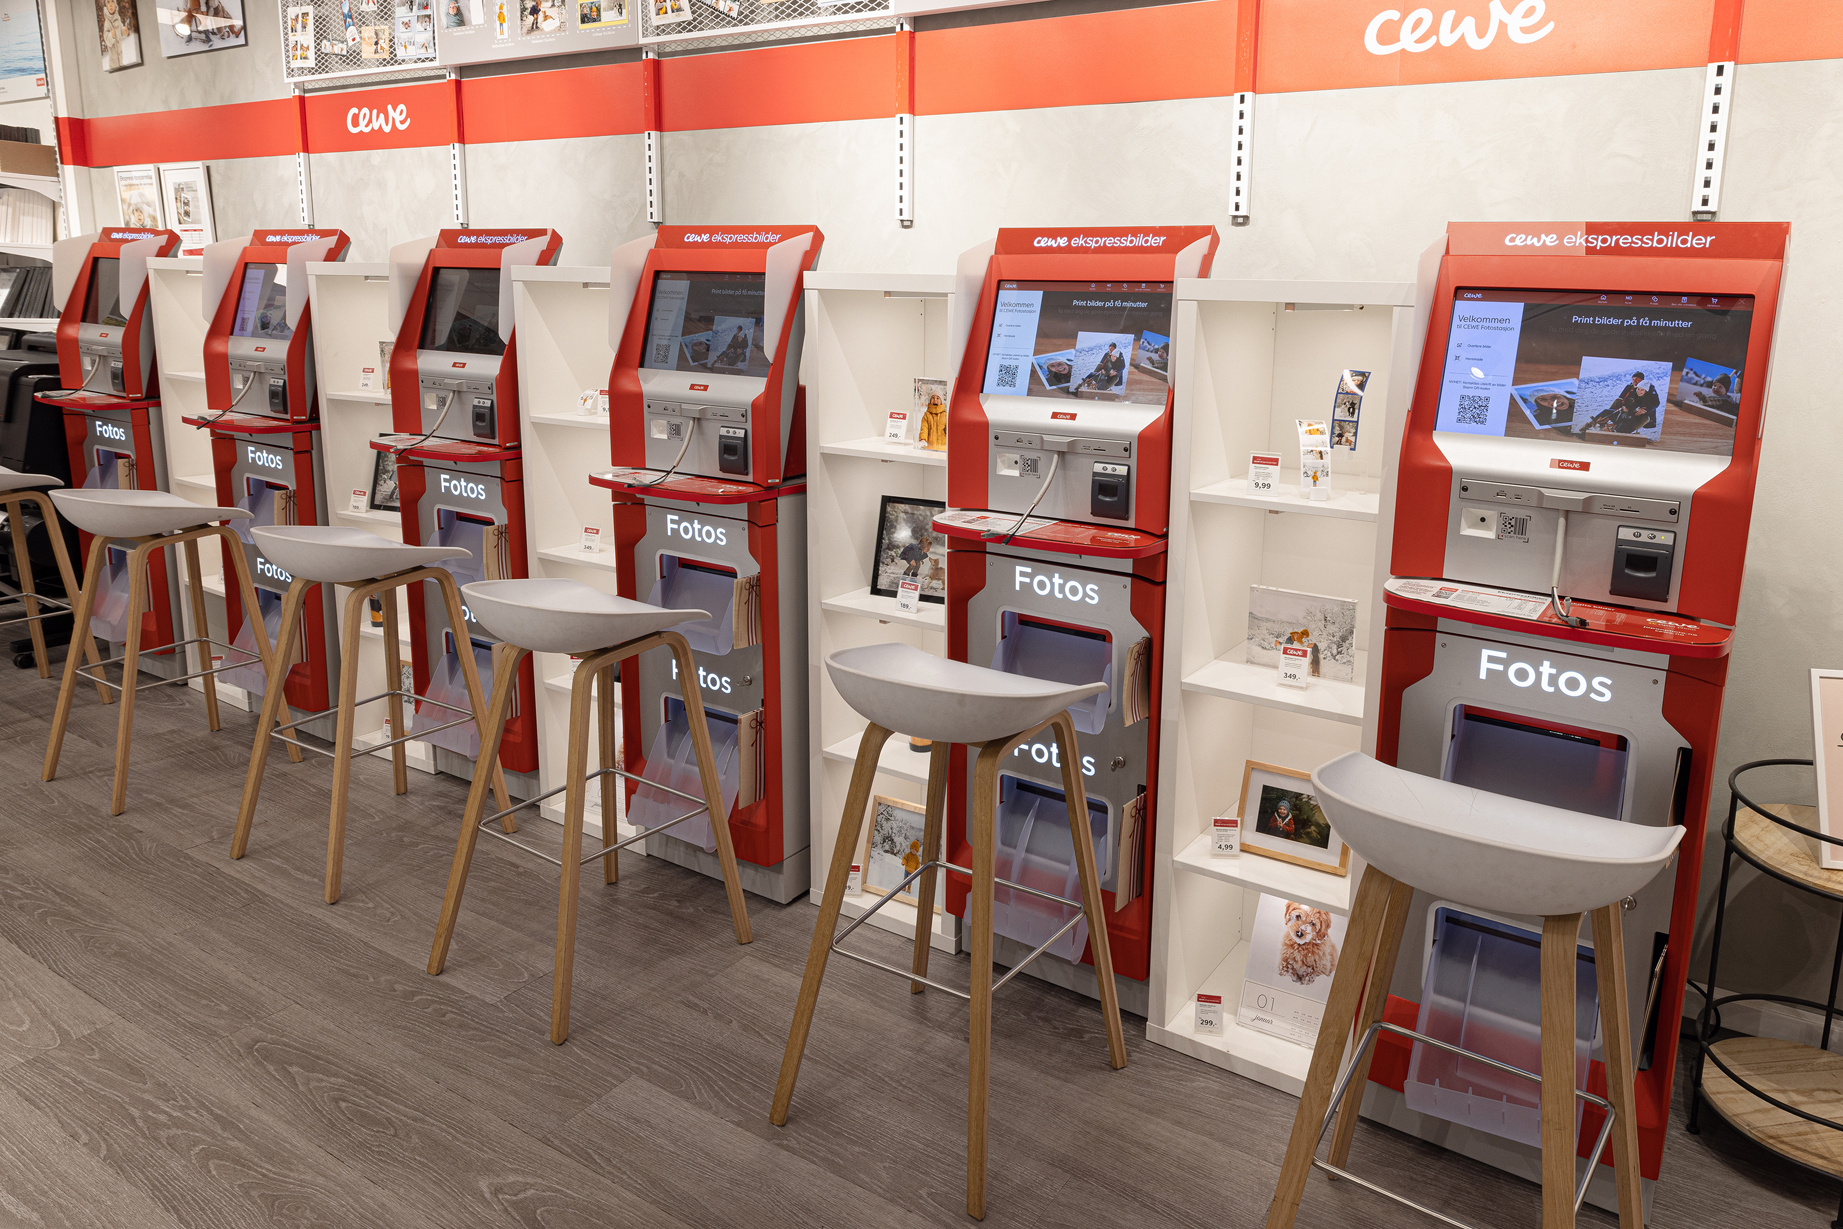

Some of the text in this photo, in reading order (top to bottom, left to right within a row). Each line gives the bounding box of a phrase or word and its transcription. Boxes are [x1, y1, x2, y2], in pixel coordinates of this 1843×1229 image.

[1364, 0, 1555, 56] cewe
[346, 103, 411, 134] cewe
[281, 234, 320, 243] ekspressbilder
[477, 234, 528, 245] ekspressbilder
[684, 232, 782, 244] cewe ekspressbilder
[1033, 234, 1167, 249] cewe ekspressbilder
[1504, 231, 1716, 250] cewe ekspressbilder
[1458, 315, 1510, 324] Velkommen
[1572, 316, 1692, 328] Print bilder på få minutter
[95, 420, 126, 441] Fotos
[247, 446, 283, 470] Fotos
[440, 473, 486, 500] Fotos
[666, 514, 727, 546] Fotos
[257, 557, 292, 583] Fotos
[1015, 565, 1099, 605] Fotos
[672, 658, 732, 694] Ftos
[1479, 648, 1613, 703] Fotos
[1014, 738, 1096, 776] ots
[1257, 994, 1274, 1011] 01
